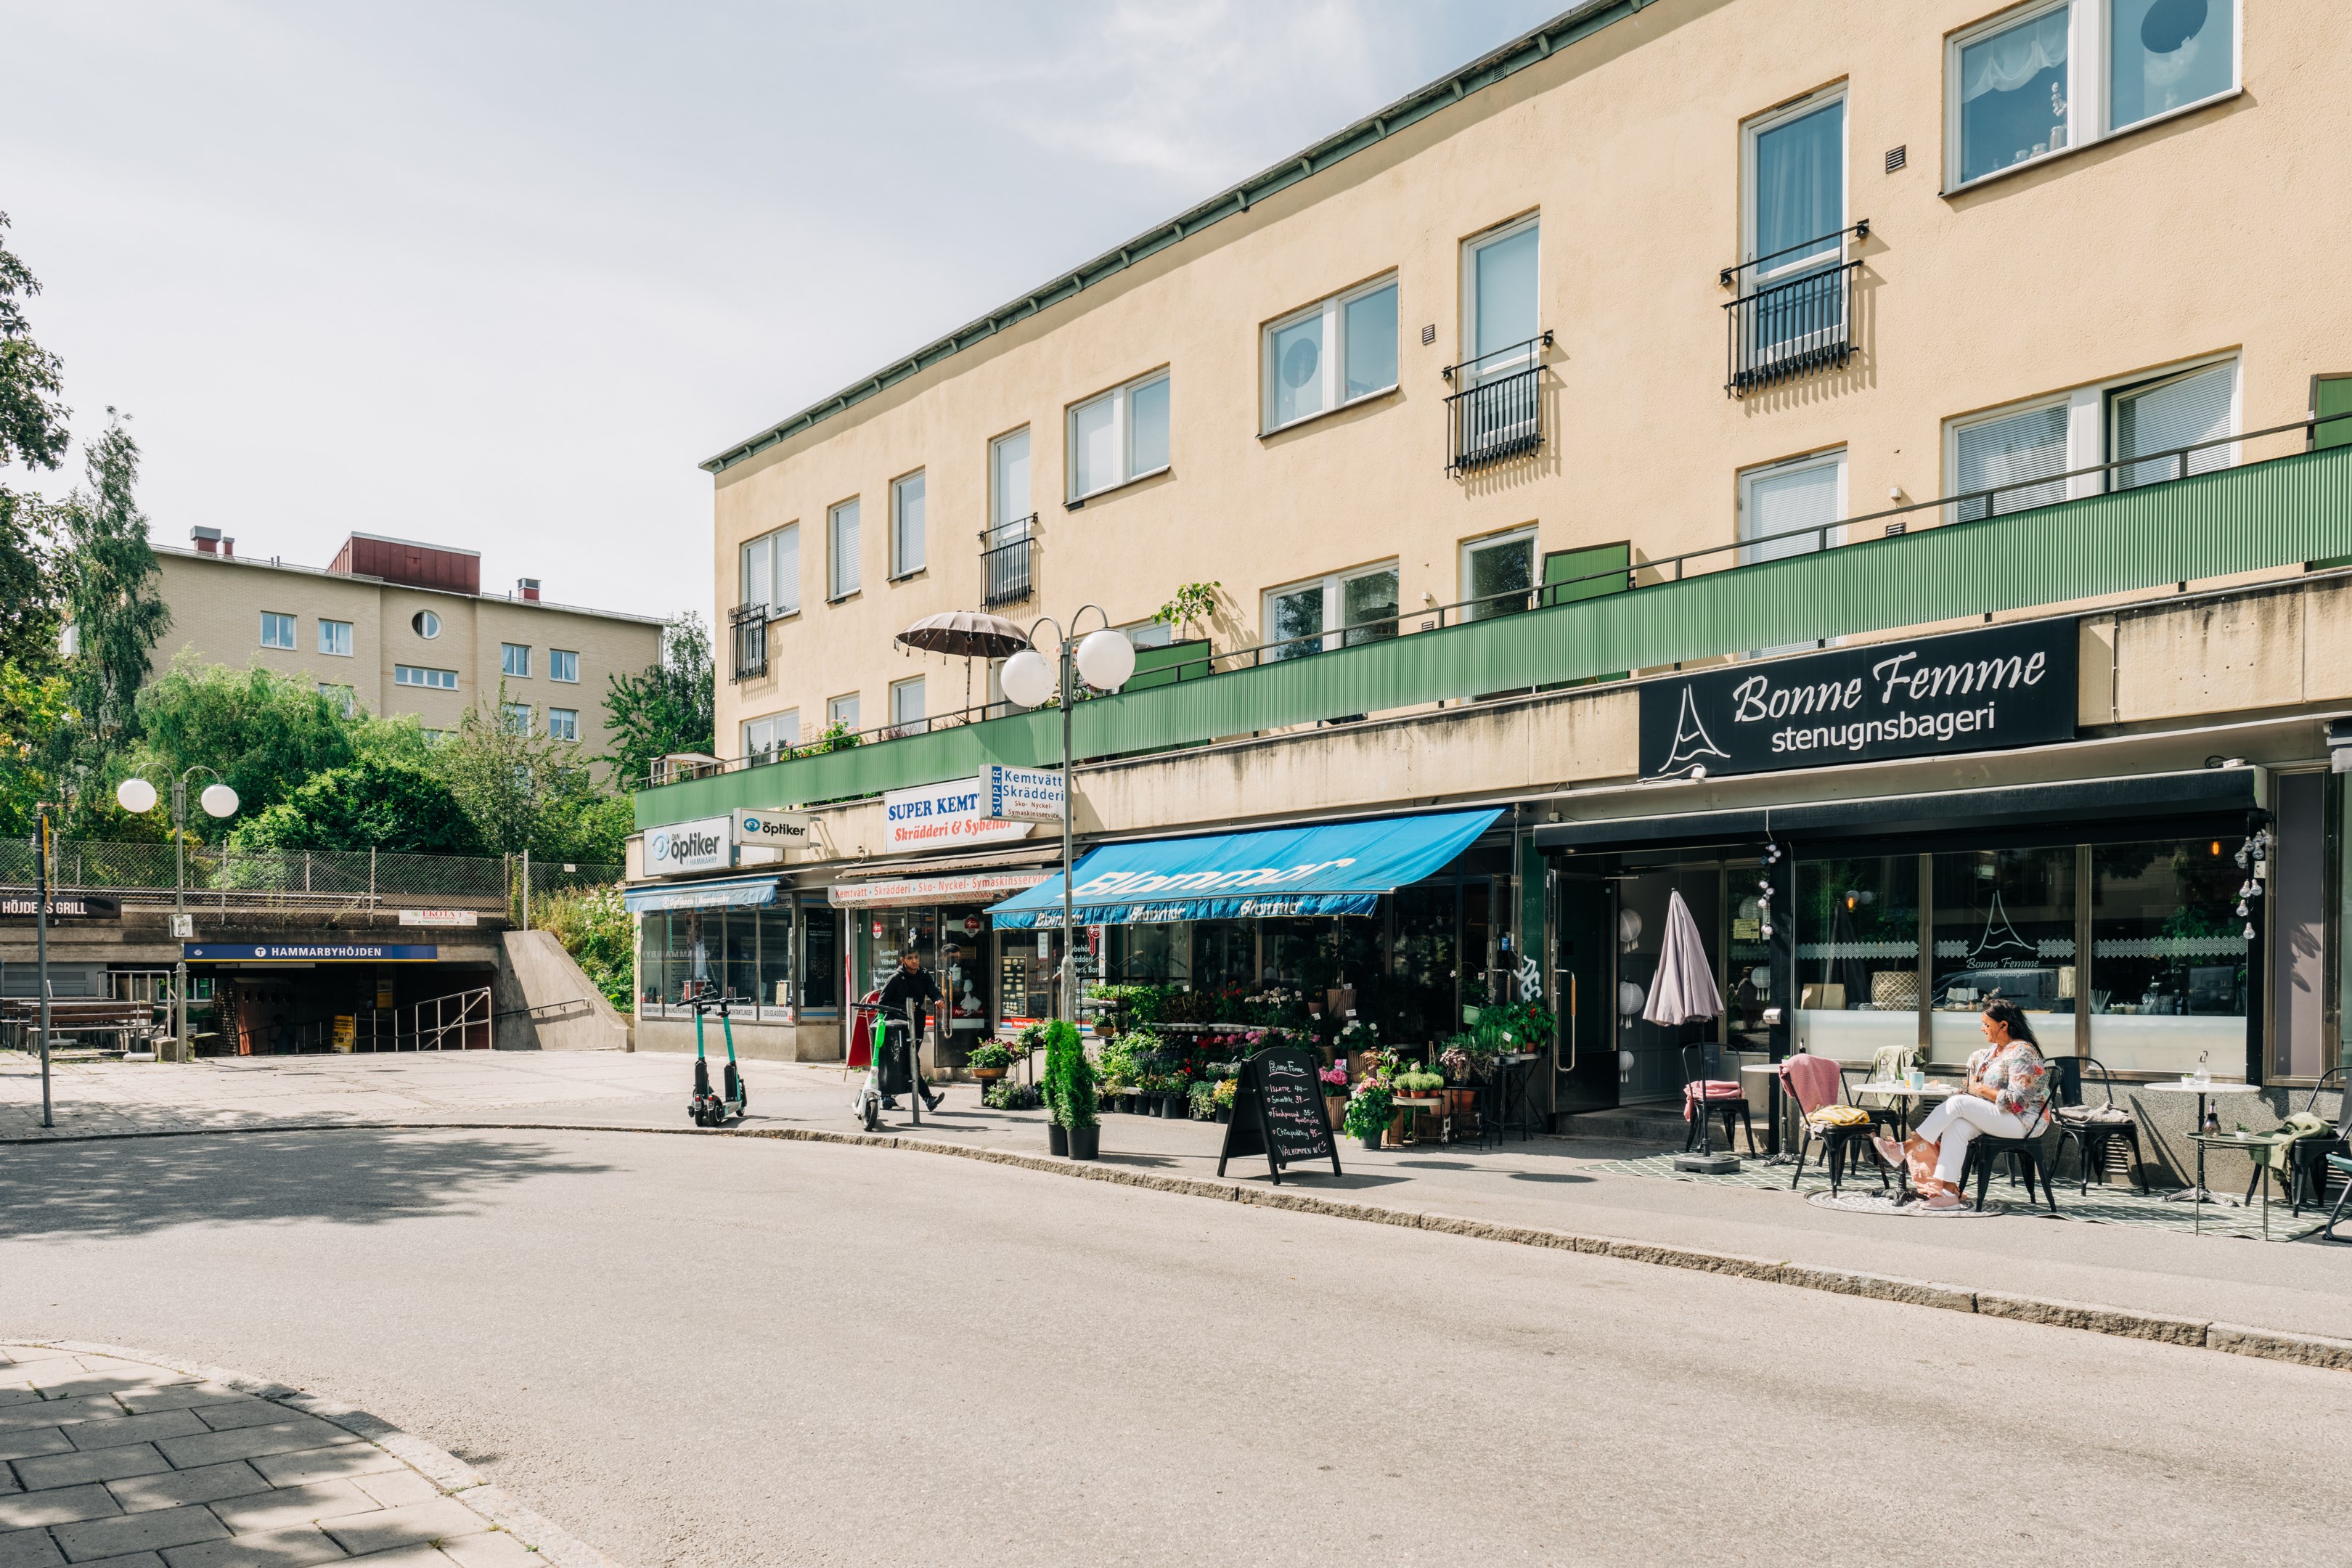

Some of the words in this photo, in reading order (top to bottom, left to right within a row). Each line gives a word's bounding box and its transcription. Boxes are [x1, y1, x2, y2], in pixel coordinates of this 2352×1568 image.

[1732, 675, 1862, 722] Bonne
[1873, 651, 2046, 703] Femme
[1771, 701, 1995, 752] stenugnsbageri
[1005, 769, 1062, 786] Kemtvätt
[992, 769, 1001, 813] SUPER
[1003, 785, 1064, 801] Skrädderi
[889, 800, 932, 820] SUPER
[937, 792, 980, 814] KEMT
[762, 823, 805, 836] optiker
[895, 821, 948, 841] Skrädderi
[951, 820, 962, 834] &
[671, 832, 720, 865] optiker
[836, 889, 867, 898] Kemtvätt
[874, 883, 910, 895] Skrädderi
[972, 873, 1051, 890] Symaskinsservice
[1056, 857, 1357, 899] Blommor
[2, 899, 54, 914] HÖJDES
[56, 902, 87, 915] GRILL
[271, 946, 382, 957] HAMMARBYHÖJDEN
[1967, 957, 1998, 968] Bonne
[2001, 957, 2039, 968] Femme
